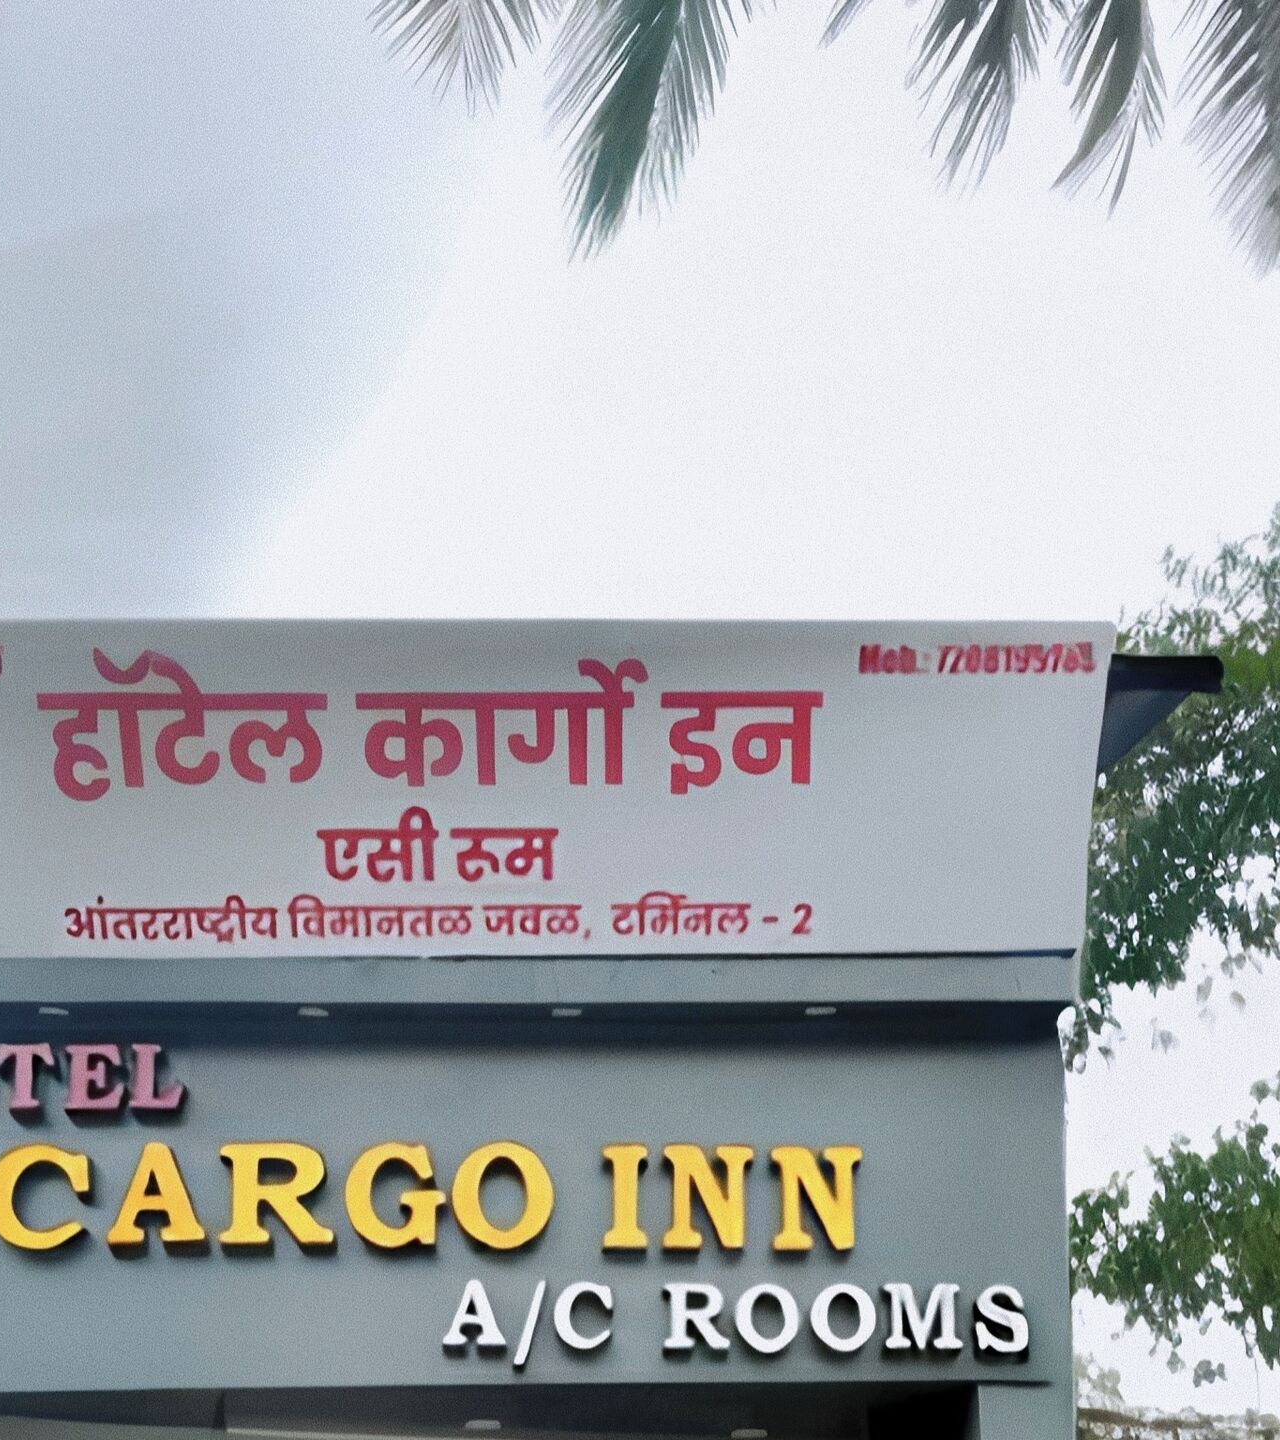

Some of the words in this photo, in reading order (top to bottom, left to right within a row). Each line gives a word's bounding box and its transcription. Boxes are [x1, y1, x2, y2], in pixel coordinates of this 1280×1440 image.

[37, 648, 327, 801] हॉटेल
[356, 658, 648, 787] कार्गो
[660, 690, 824, 795] इन
[316, 805, 440, 883] एसी
[450, 826, 560, 884] रूम
[287, 893, 473, 939] विमानतळ
[482, 903, 592, 940] जवळ,
[611, 891, 752, 937] टर्मिनल
[762, 915, 780, 924] -
[790, 902, 814, 936] 2
[602, 1142, 864, 1252] INN
[442, 1278, 614, 1367] A/C
[663, 1281, 1030, 1356] ROOMS
